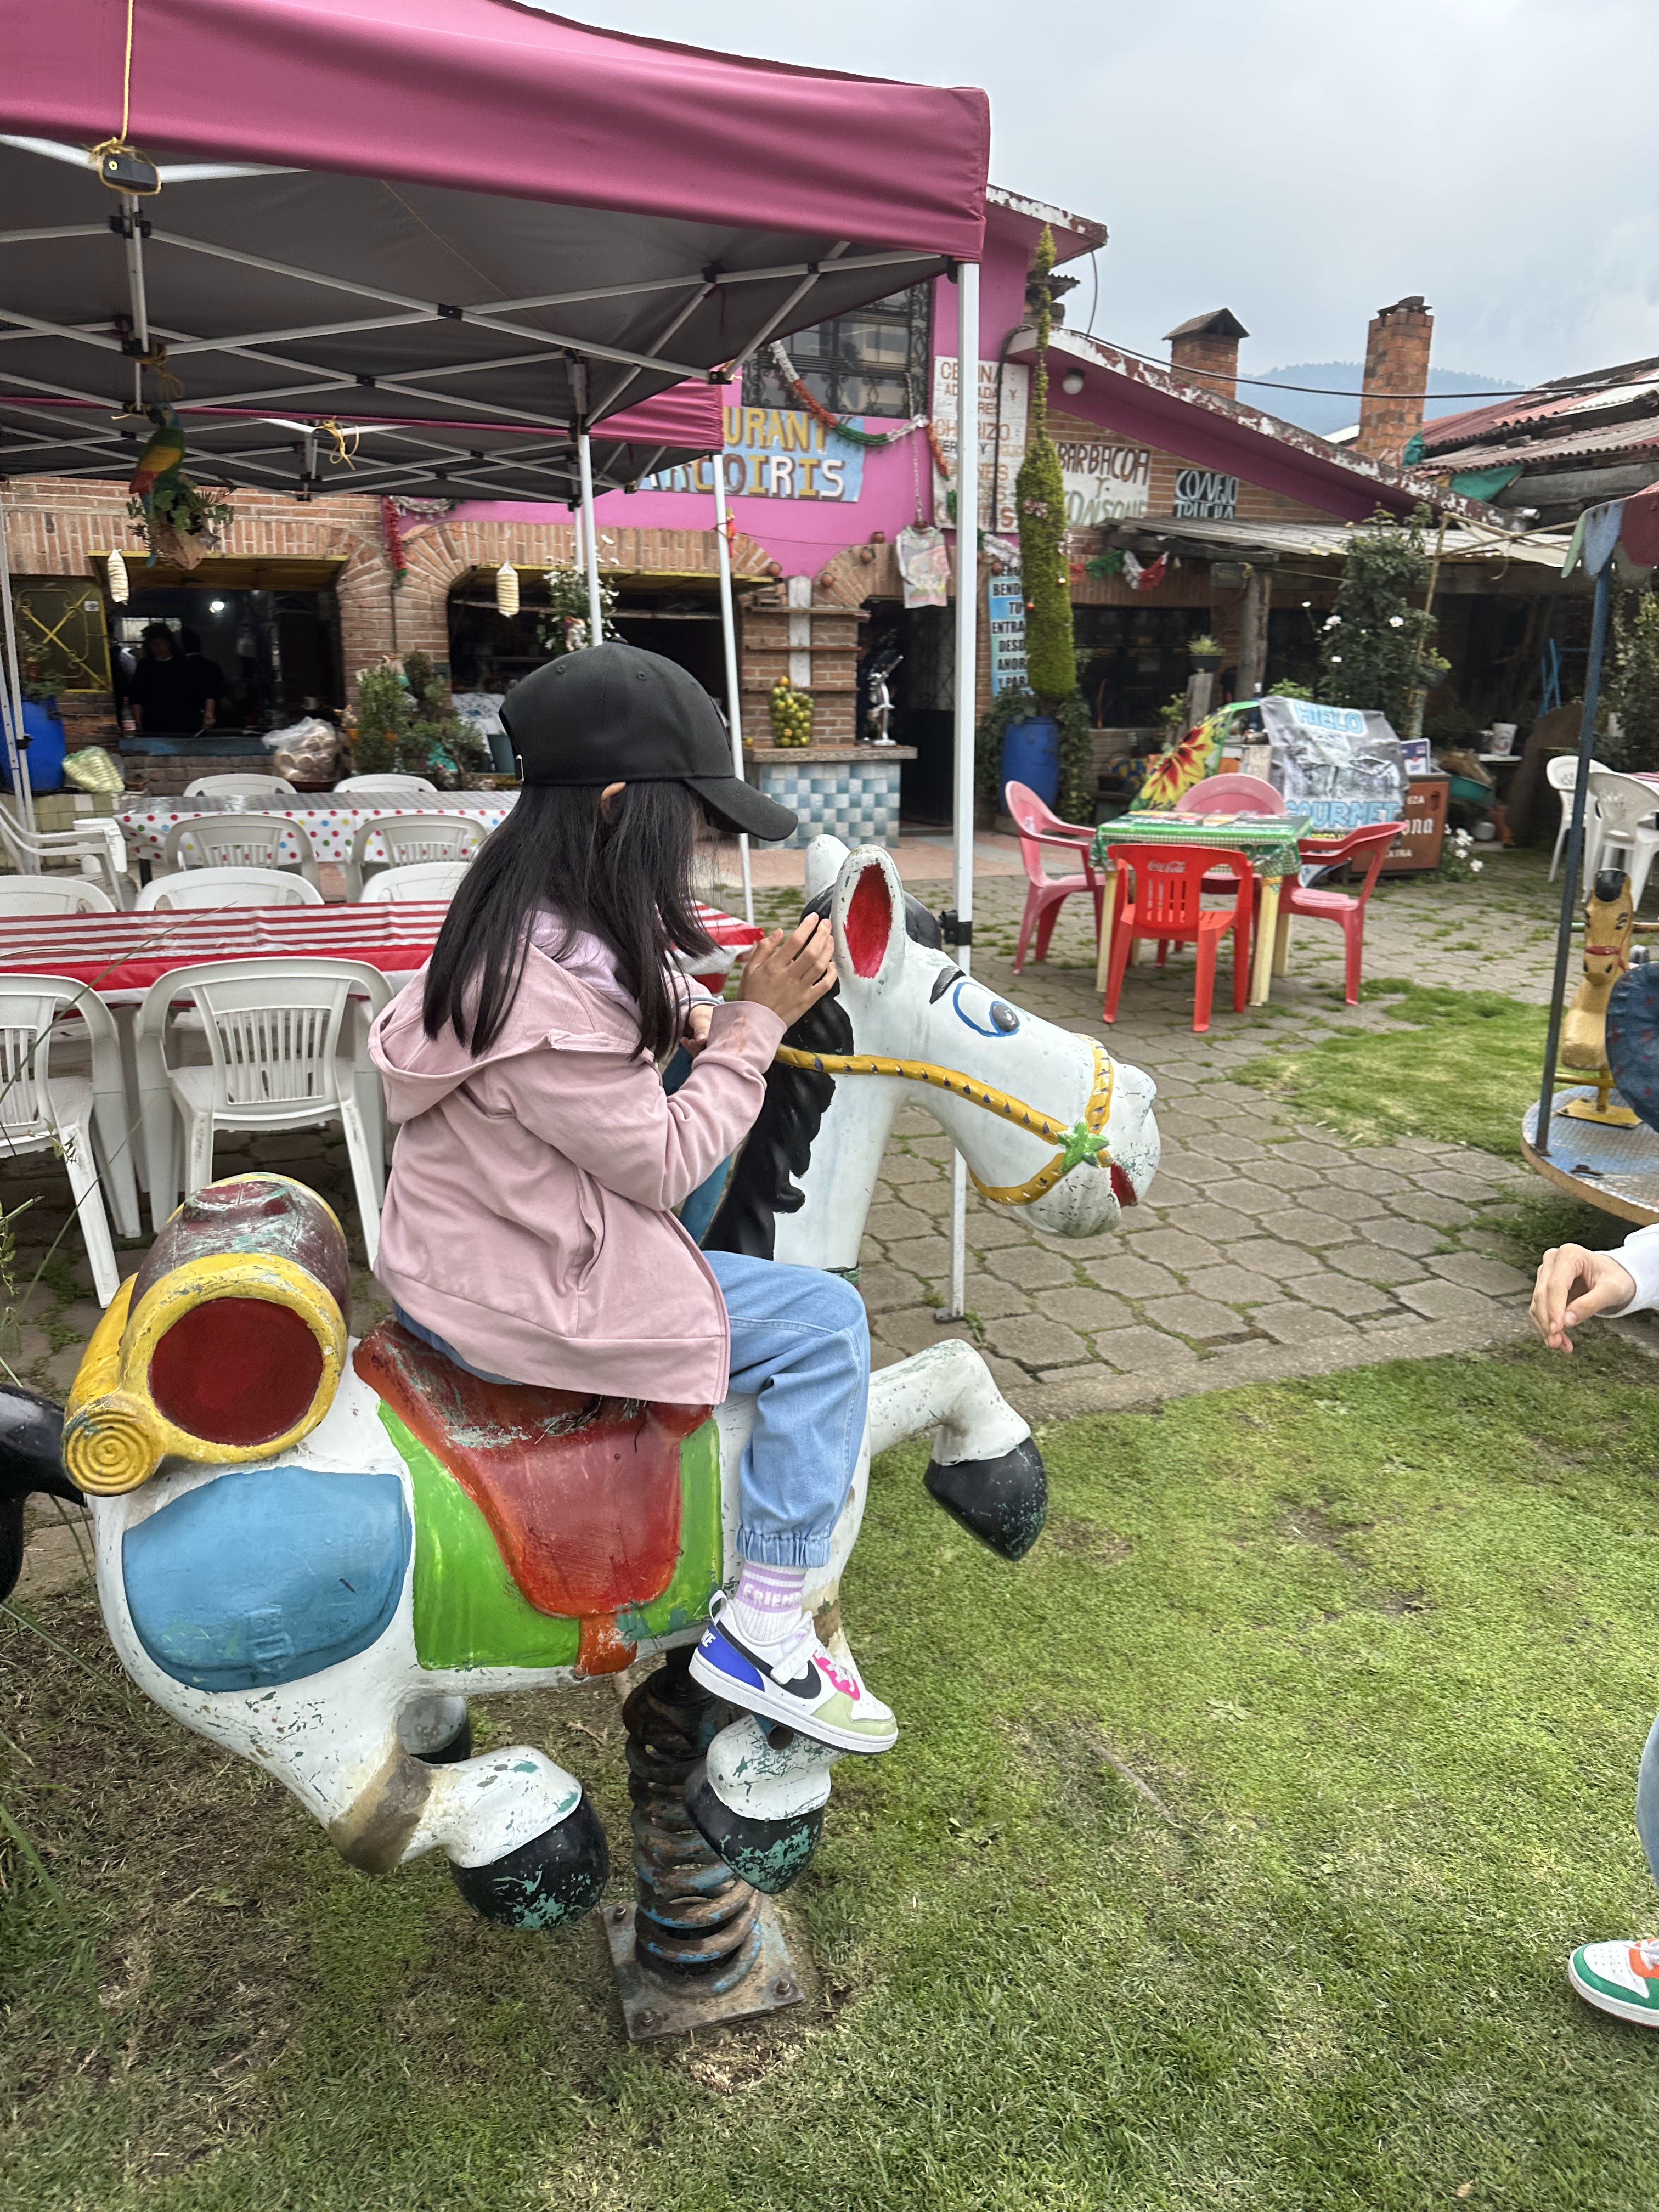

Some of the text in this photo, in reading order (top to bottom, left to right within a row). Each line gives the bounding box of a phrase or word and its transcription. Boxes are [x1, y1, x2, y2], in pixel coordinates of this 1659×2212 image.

[1058, 442, 1150, 486] BARBACOA
[1176, 470, 1239, 504] CONEJO
[1294, 702, 1364, 734] HIELO
